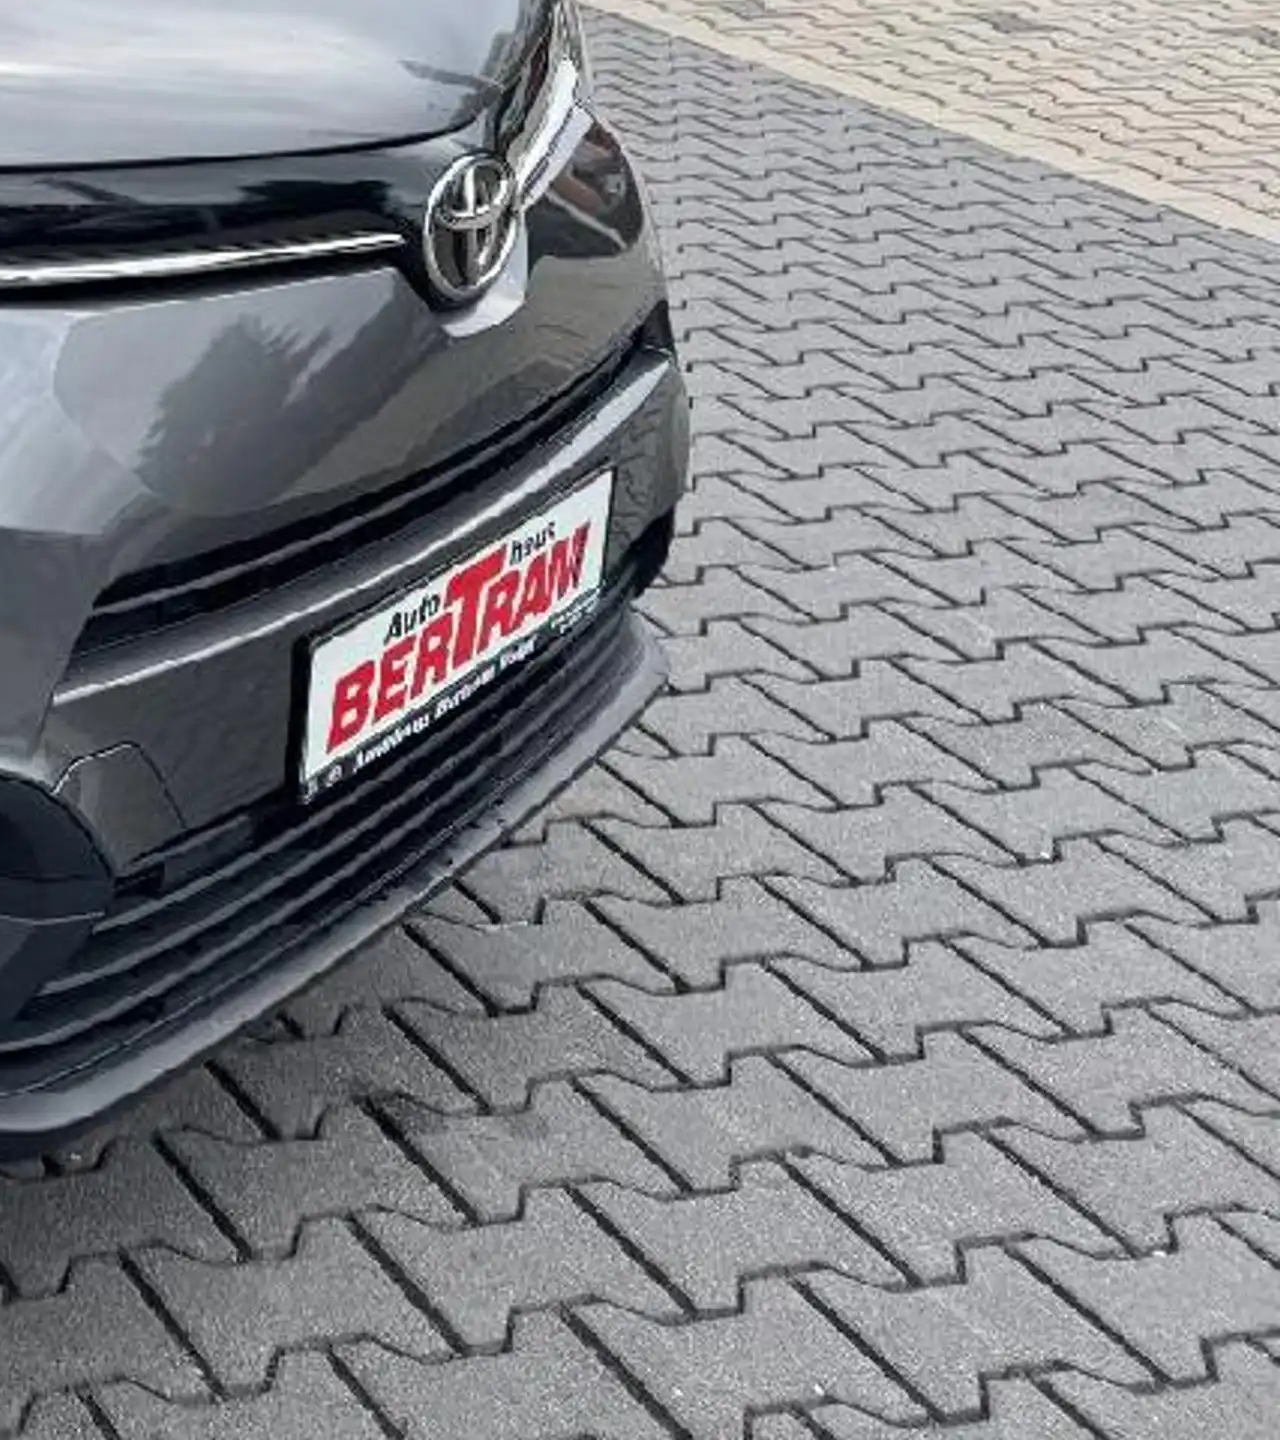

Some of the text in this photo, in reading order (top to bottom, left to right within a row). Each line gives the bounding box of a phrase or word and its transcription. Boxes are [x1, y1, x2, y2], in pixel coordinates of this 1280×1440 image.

[325, 520, 592, 756] BERTRAM
[385, 520, 557, 645] Auto haus
